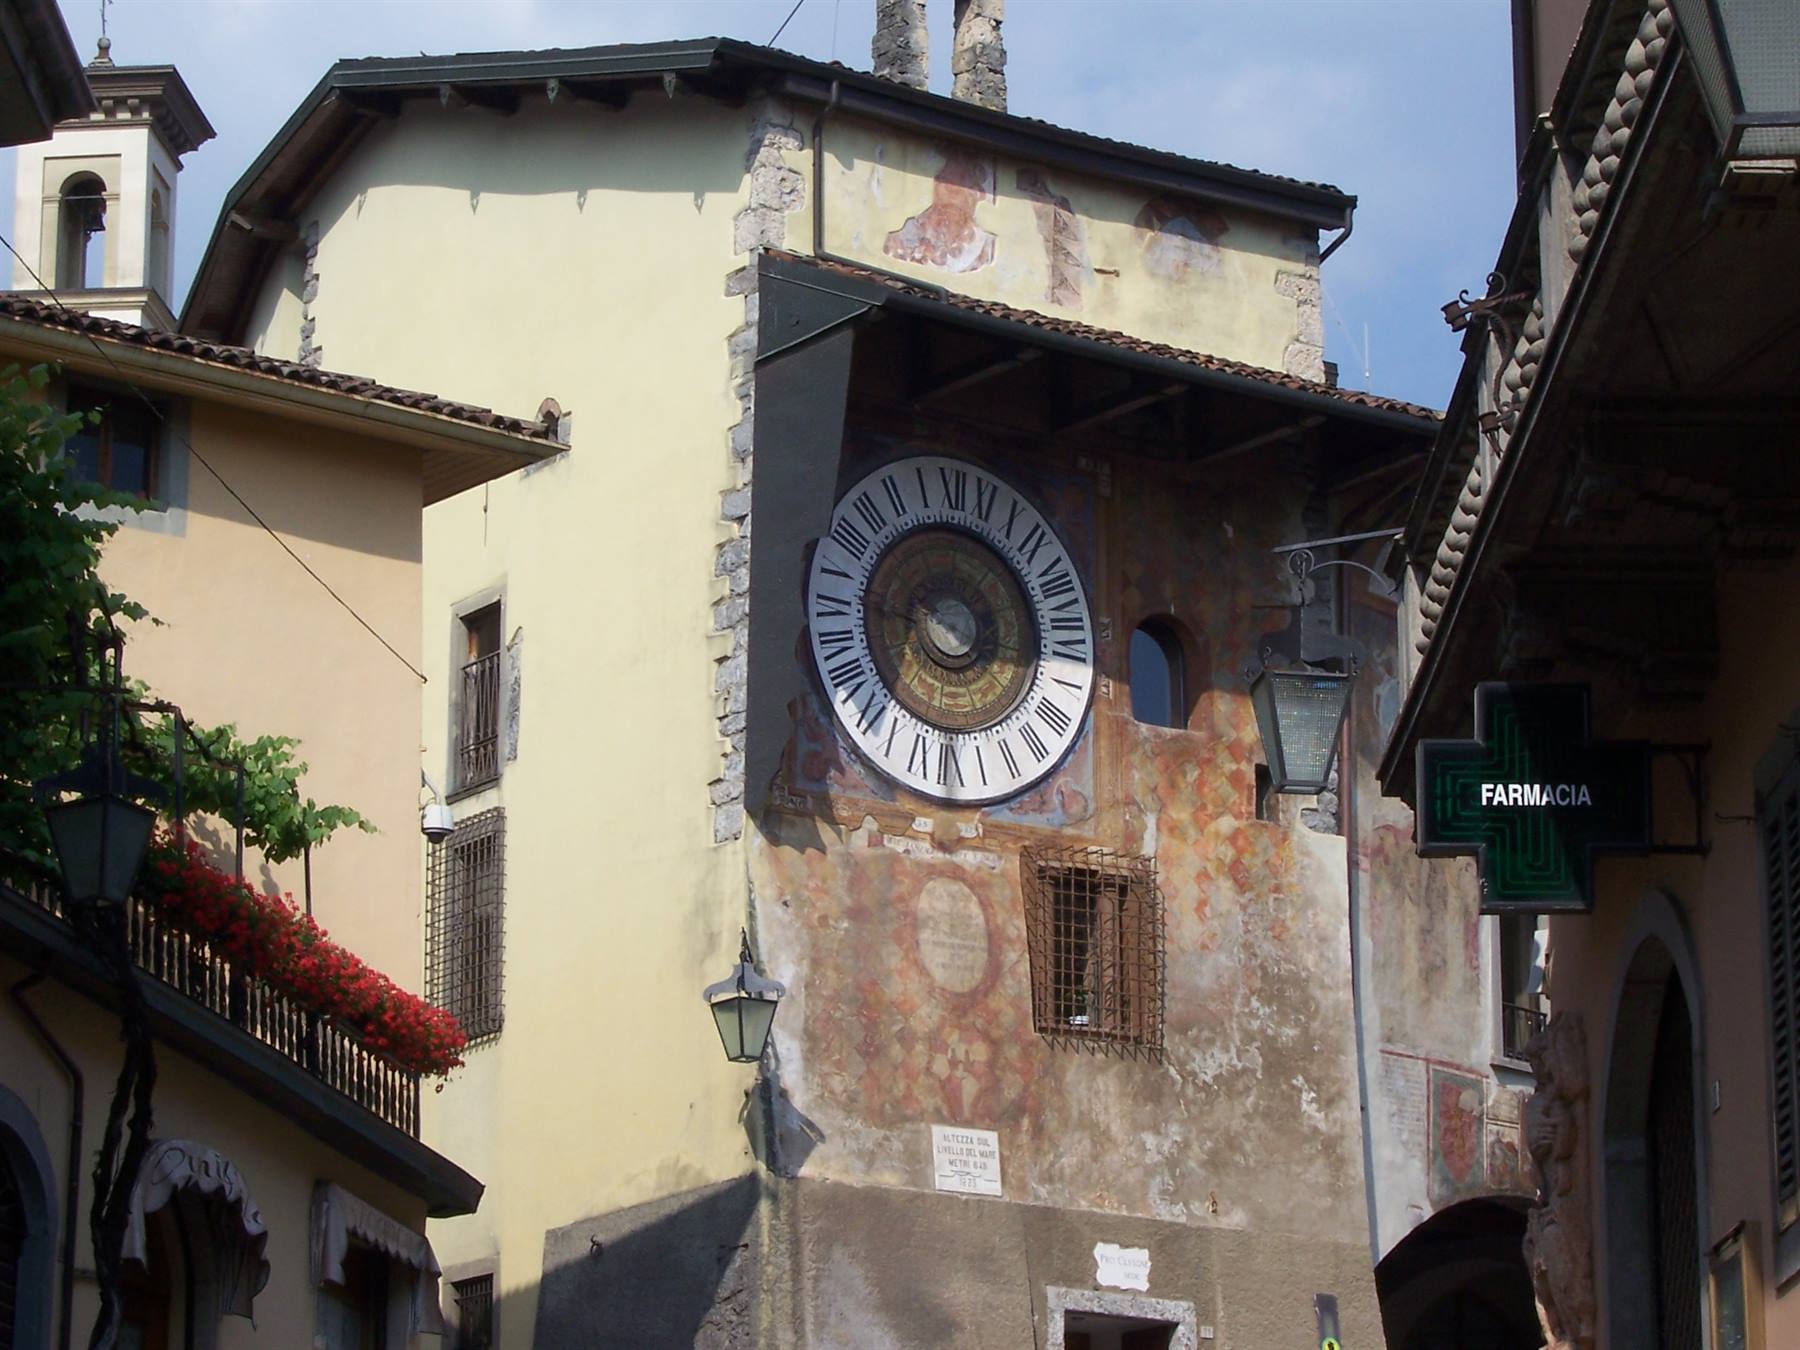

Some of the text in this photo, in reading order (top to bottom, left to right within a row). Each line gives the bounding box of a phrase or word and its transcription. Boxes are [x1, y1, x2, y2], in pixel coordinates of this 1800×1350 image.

[939, 467, 967, 512] XII
[970, 477, 999, 522] XI
[1000, 498, 1027, 541] X
[820, 554, 855, 580] V
[1036, 555, 1076, 600] VIII
[1049, 597, 1085, 631] VII
[875, 716, 908, 760] X
[1481, 783, 1592, 806] FARMACIA
[937, 1144, 965, 1157] LIVELLO
[965, 1147, 978, 1158] DEL
[943, 1133, 974, 1145] ALTEZZA
